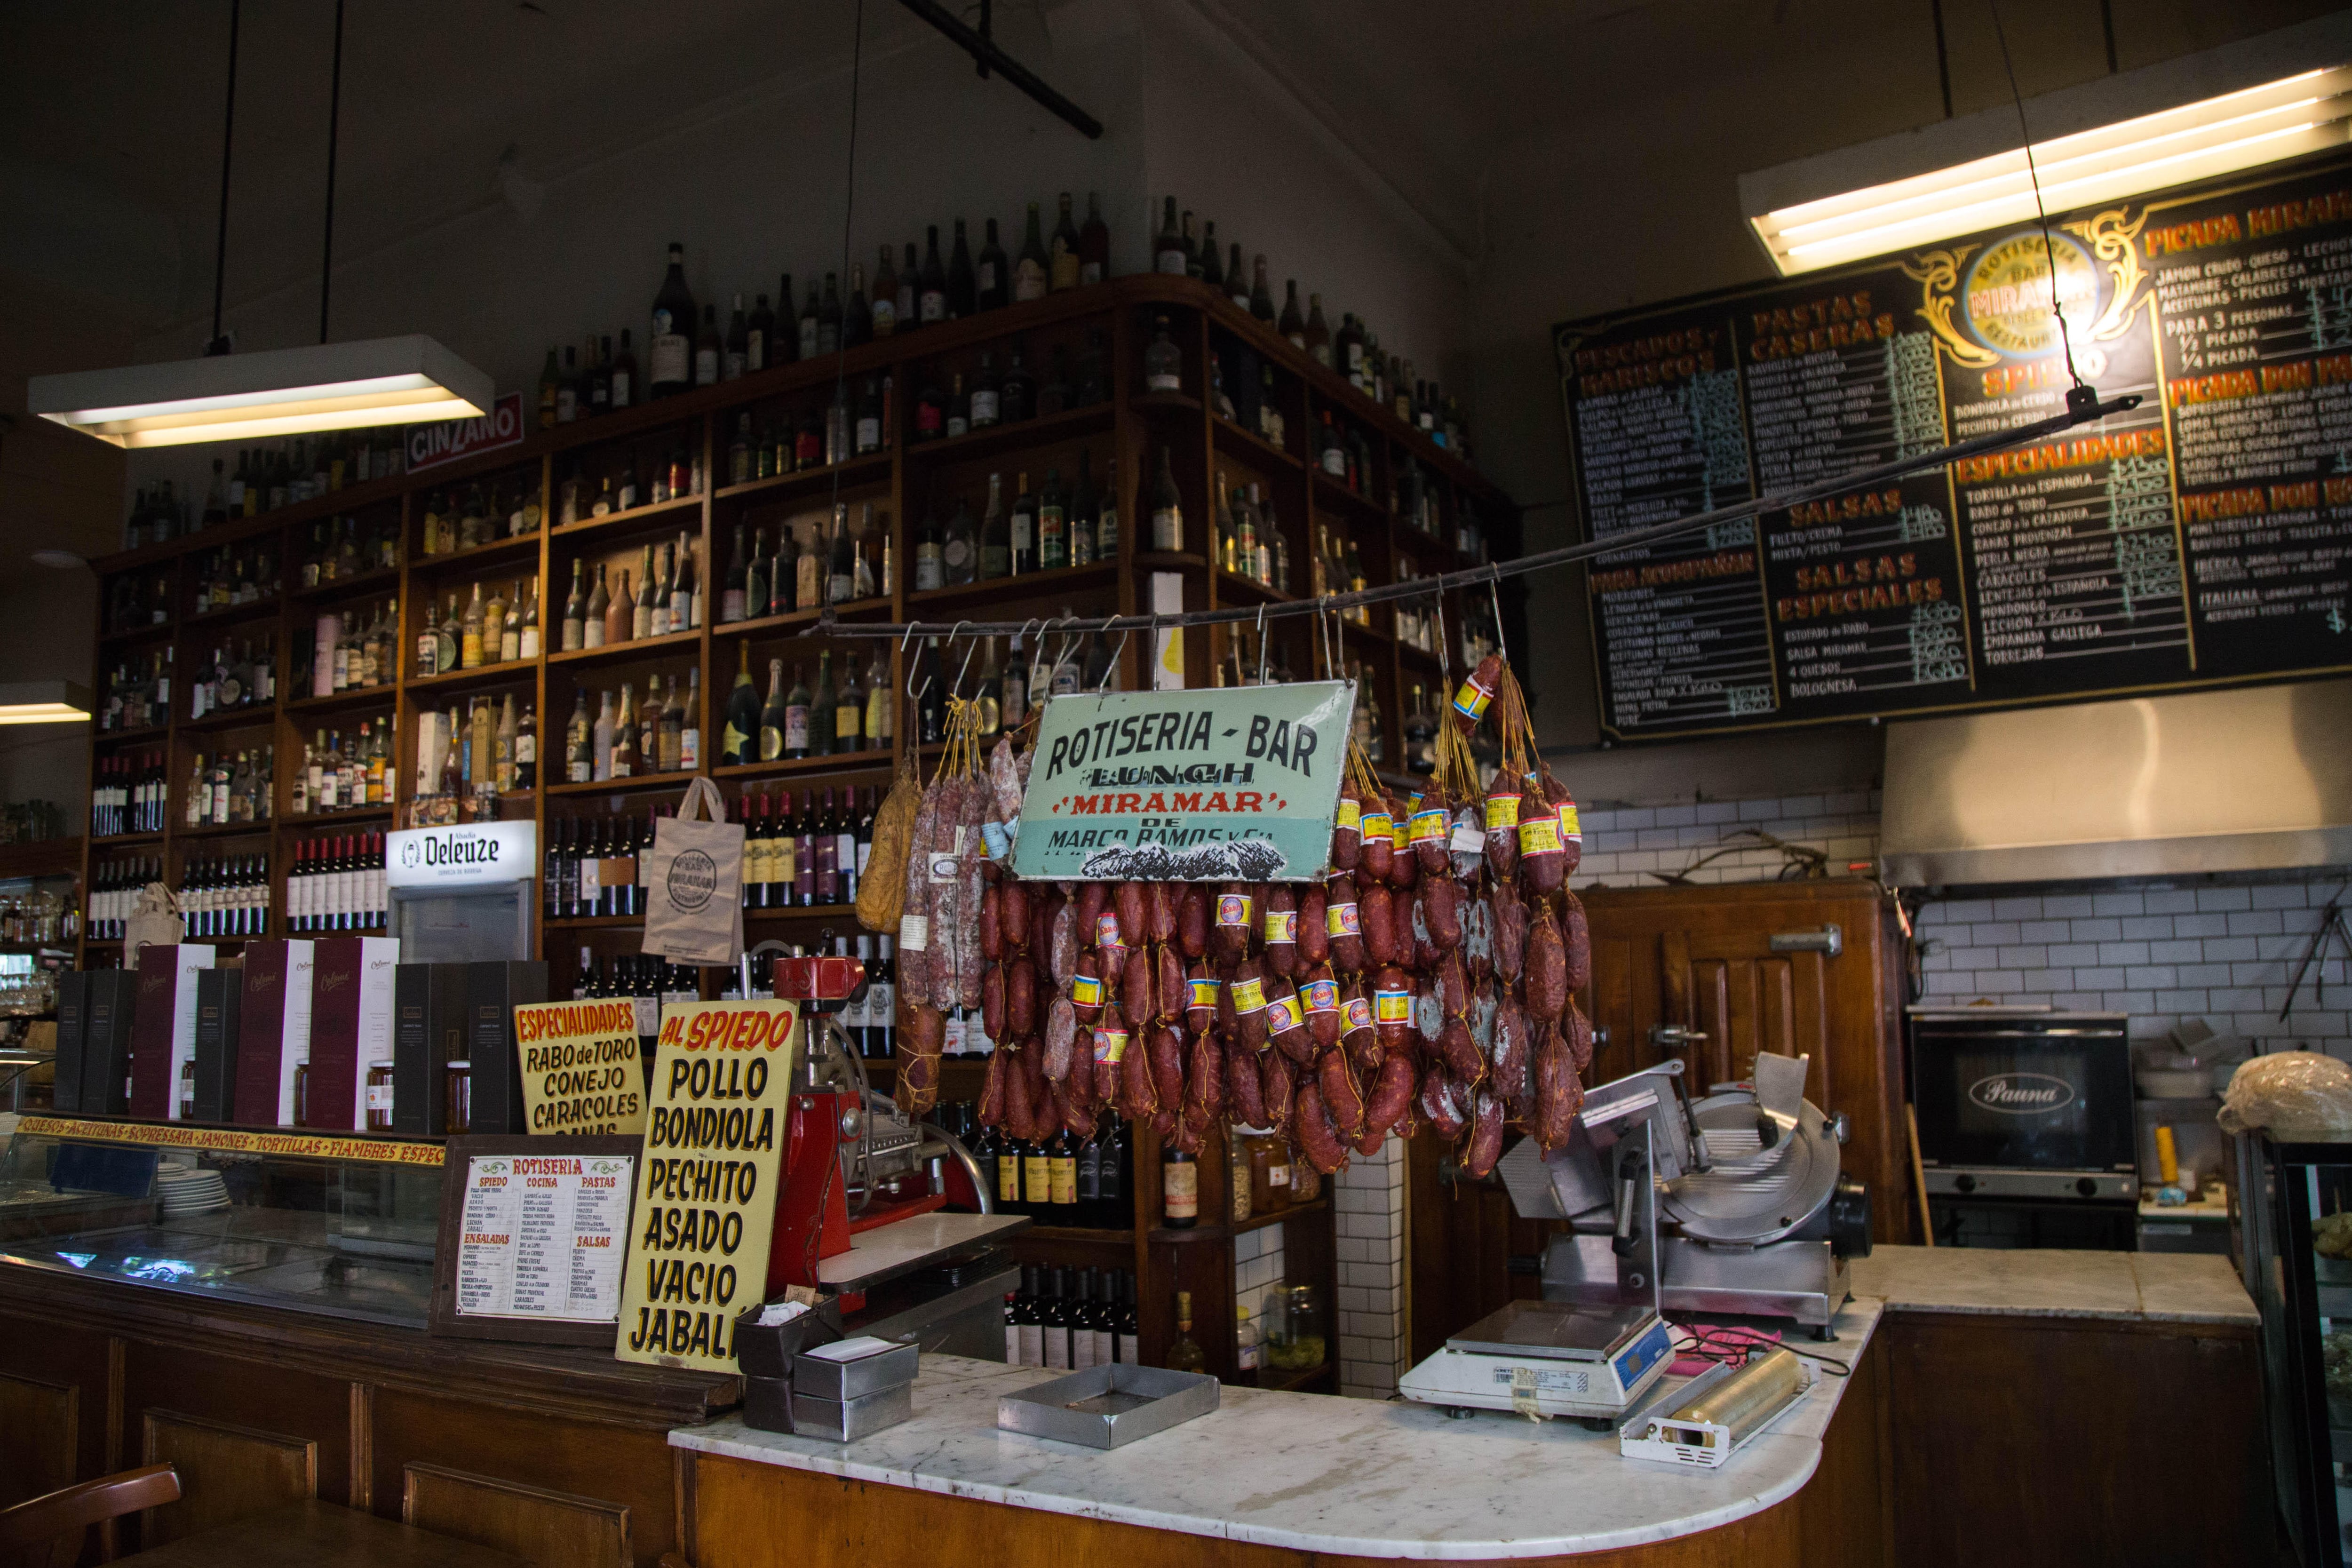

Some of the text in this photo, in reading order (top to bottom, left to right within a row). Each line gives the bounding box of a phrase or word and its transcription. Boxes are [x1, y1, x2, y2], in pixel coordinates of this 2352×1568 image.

[2145, 214, 2241, 257] PICADA
[2166, 315, 2209, 337] PARA
[2214, 310, 2226, 330] 3
[2205, 327, 2259, 349] PICADA
[2207, 345, 2259, 367] PICADA
[2168, 367, 2258, 409] PICADA
[411, 407, 515, 462] CINZANO
[1956, 428, 2166, 484] ESPECIALIDADES
[1789, 489, 1903, 527] SALSAS
[1796, 552, 1917, 590] SALSAS
[1777, 577, 1942, 622] ESPECIALES
[1046, 711, 1214, 781] ROTISERIA
[1245, 714, 1318, 778] BAR
[1090, 762, 1255, 788] LUNCH
[1048, 829, 1128, 848] MARCO
[1136, 827, 1224, 847] RAMOS
[1141, 817, 1182, 828] DE
[424, 833, 499, 866] Deleuze
[1223, 906, 1240, 914] EBRO
[1313, 990, 1331, 1001] EBRO
[518, 1002, 634, 1043] ESPECIALIDADES
[660, 1010, 793, 1052] AL SPIEDO
[1270, 1009, 1287, 1023] EBRO
[526, 1036, 636, 1074] RABO de TORO
[543, 1067, 626, 1098] CONEJO
[668, 1057, 769, 1101] POLLO
[533, 1092, 638, 1129] CARACOLES
[648, 1106, 774, 1151] BONDIOLA
[23, 1118, 446, 1165] QUESOS ACEITUNAS SOPRESSATA JAMONES TORTILLAS FIAMBRES ESPEC
[479, 1177, 616, 1188] SPIEDO COCINA PASTAS
[512, 1158, 583, 1176] ROTISERIA
[646, 1157, 757, 1205] PECHITO
[464, 1233, 510, 1245] ENSALADAS
[576, 1235, 611, 1248] SALSAS
[643, 1206, 743, 1255] ASADO
[647, 1258, 738, 1306] VACIO
